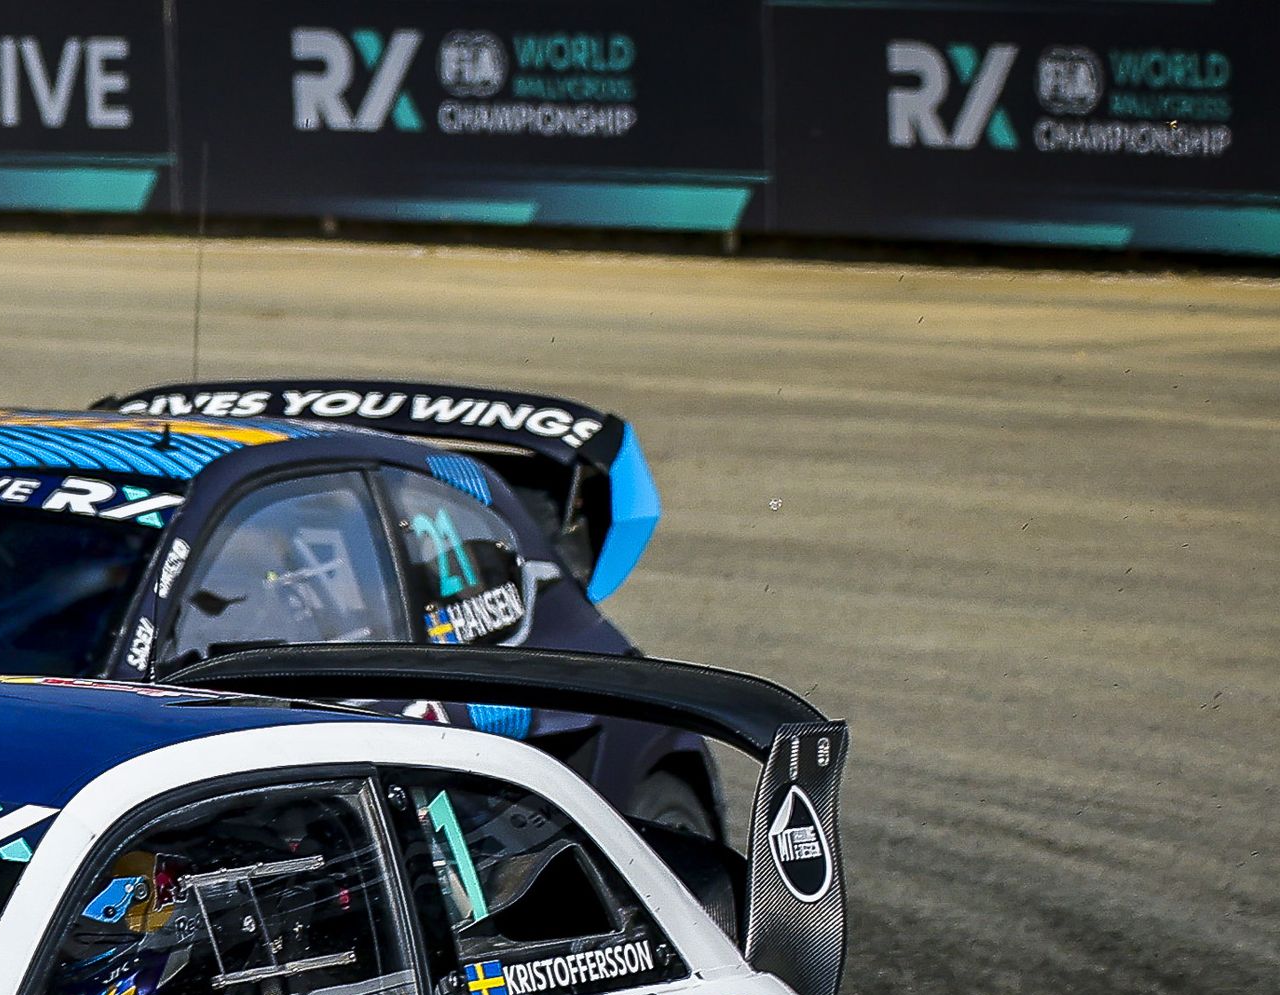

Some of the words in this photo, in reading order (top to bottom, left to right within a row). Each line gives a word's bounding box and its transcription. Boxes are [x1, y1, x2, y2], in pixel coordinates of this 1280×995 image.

[290, 27, 425, 132] RX
[513, 32, 637, 71] WORLD
[1108, 51, 1230, 89] WORLD
[886, 40, 1020, 150] RX
[281, 390, 405, 418] YOU
[411, 394, 602, 448] WINGS
[42, 476, 185, 528] RX
[412, 508, 477, 598] 21
[446, 582, 524, 643] HANSEN
[428, 790, 489, 922] 1
[503, 941, 654, 995] KRISTOFFERSSON
